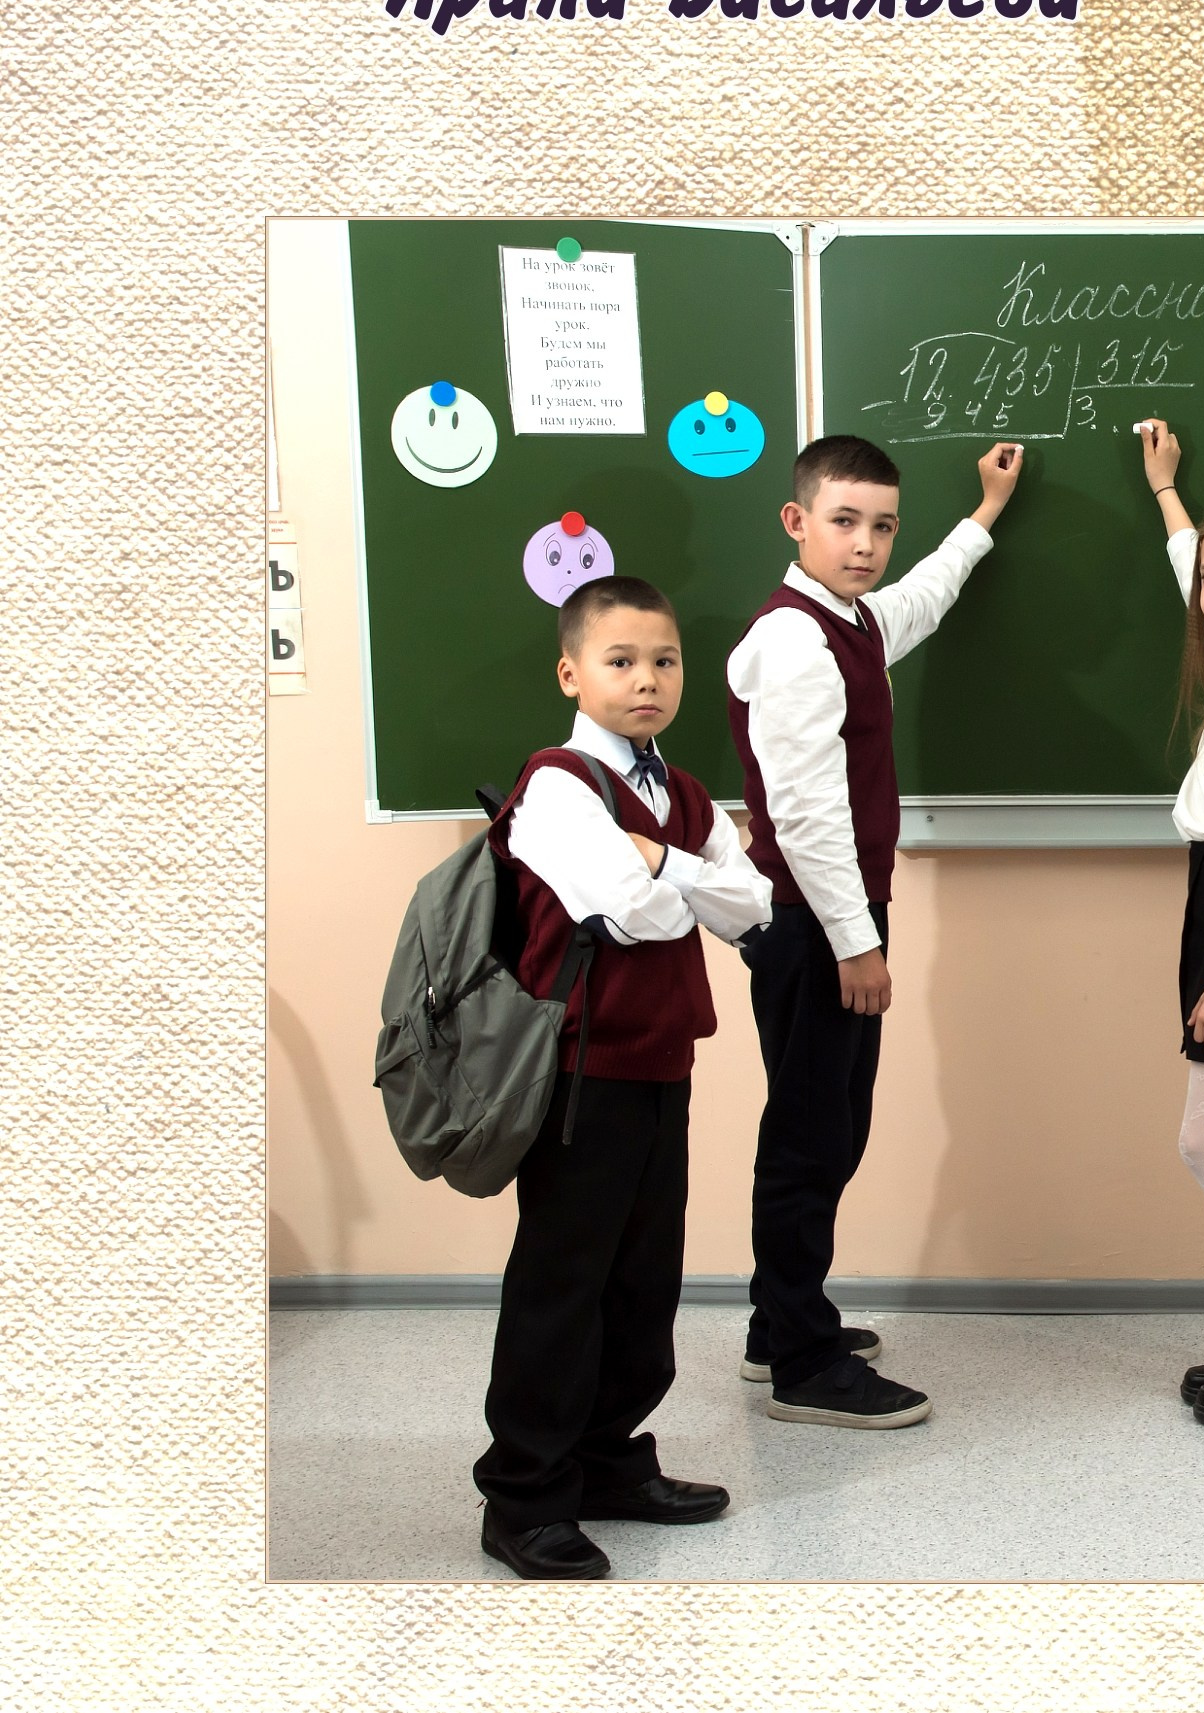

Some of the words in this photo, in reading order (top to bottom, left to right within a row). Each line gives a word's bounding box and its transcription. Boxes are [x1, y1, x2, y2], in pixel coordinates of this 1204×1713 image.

[522, 257, 540, 271] На
[544, 263, 576, 275] урок
[579, 262, 616, 274] зовёт
[521, 296, 586, 311] Начинать
[590, 302, 621, 315] пора
[540, 336, 582, 352] Будем
[586, 341, 606, 350] мы
[545, 356, 604, 371] работать
[1098, 337, 1184, 386] 315
[550, 378, 602, 391] дружно
[531, 394, 542, 406] И
[600, 398, 623, 408] что
[540, 416, 565, 426] нам
